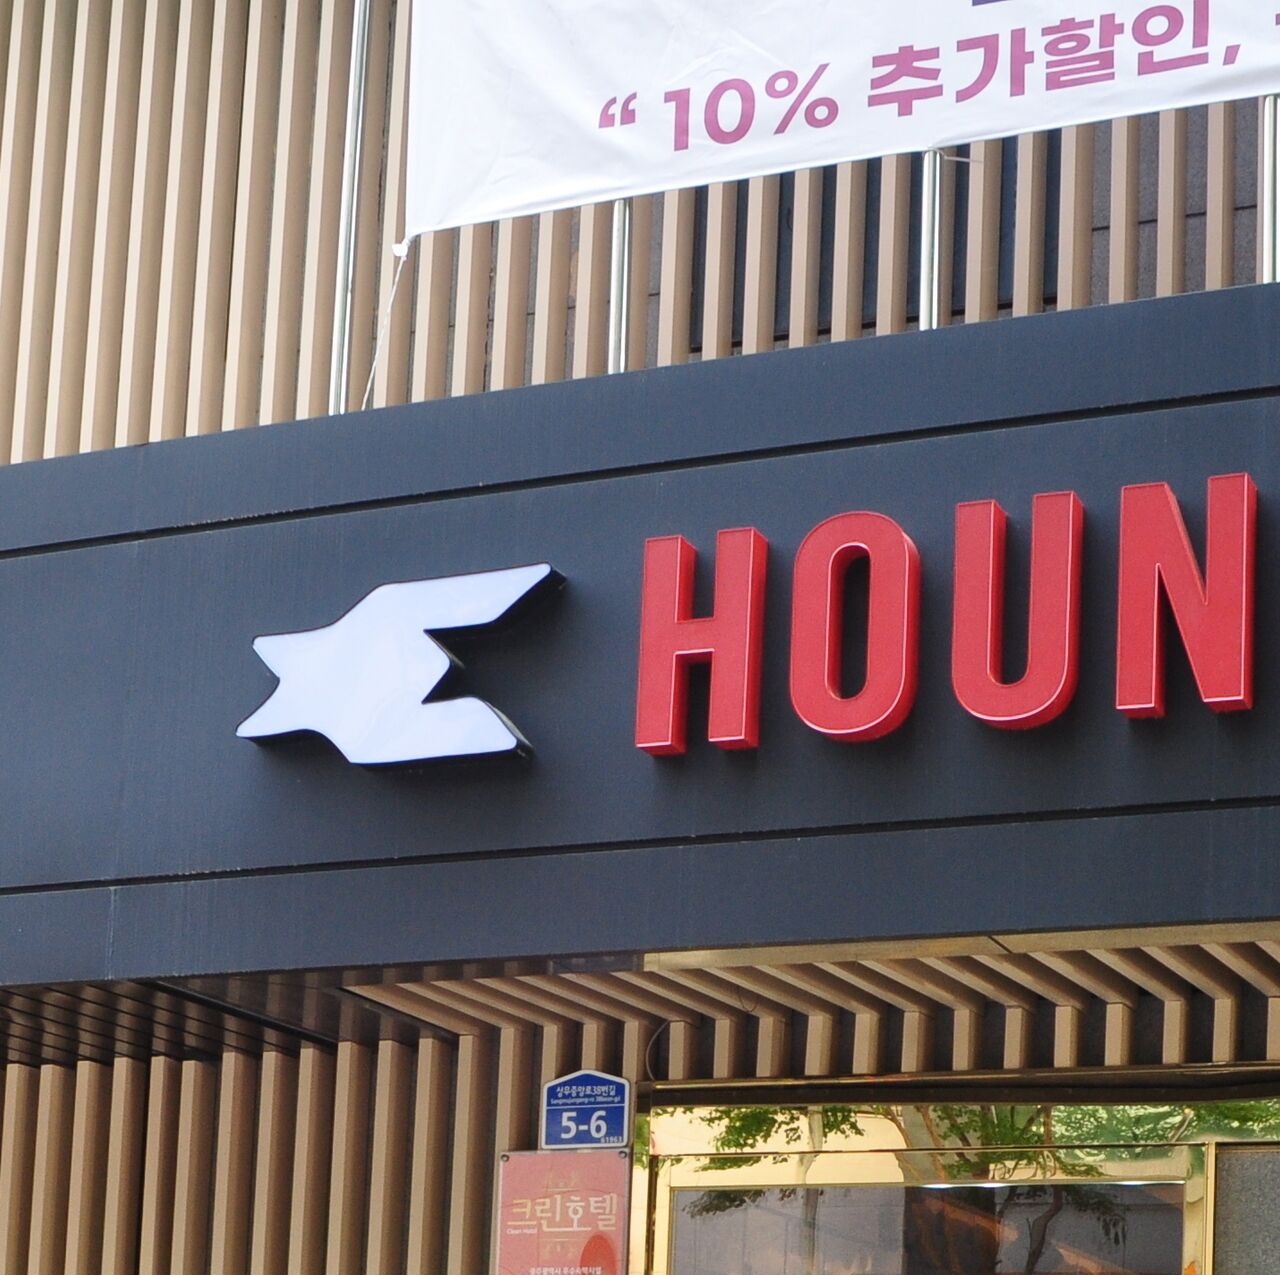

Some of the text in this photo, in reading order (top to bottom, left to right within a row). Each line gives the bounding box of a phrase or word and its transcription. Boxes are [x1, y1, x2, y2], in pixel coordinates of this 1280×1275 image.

[867, 0, 1241, 118] 추가할인,
[560, 1110, 608, 1139] 5-6
[506, 1192, 618, 1232] 크린호텔
